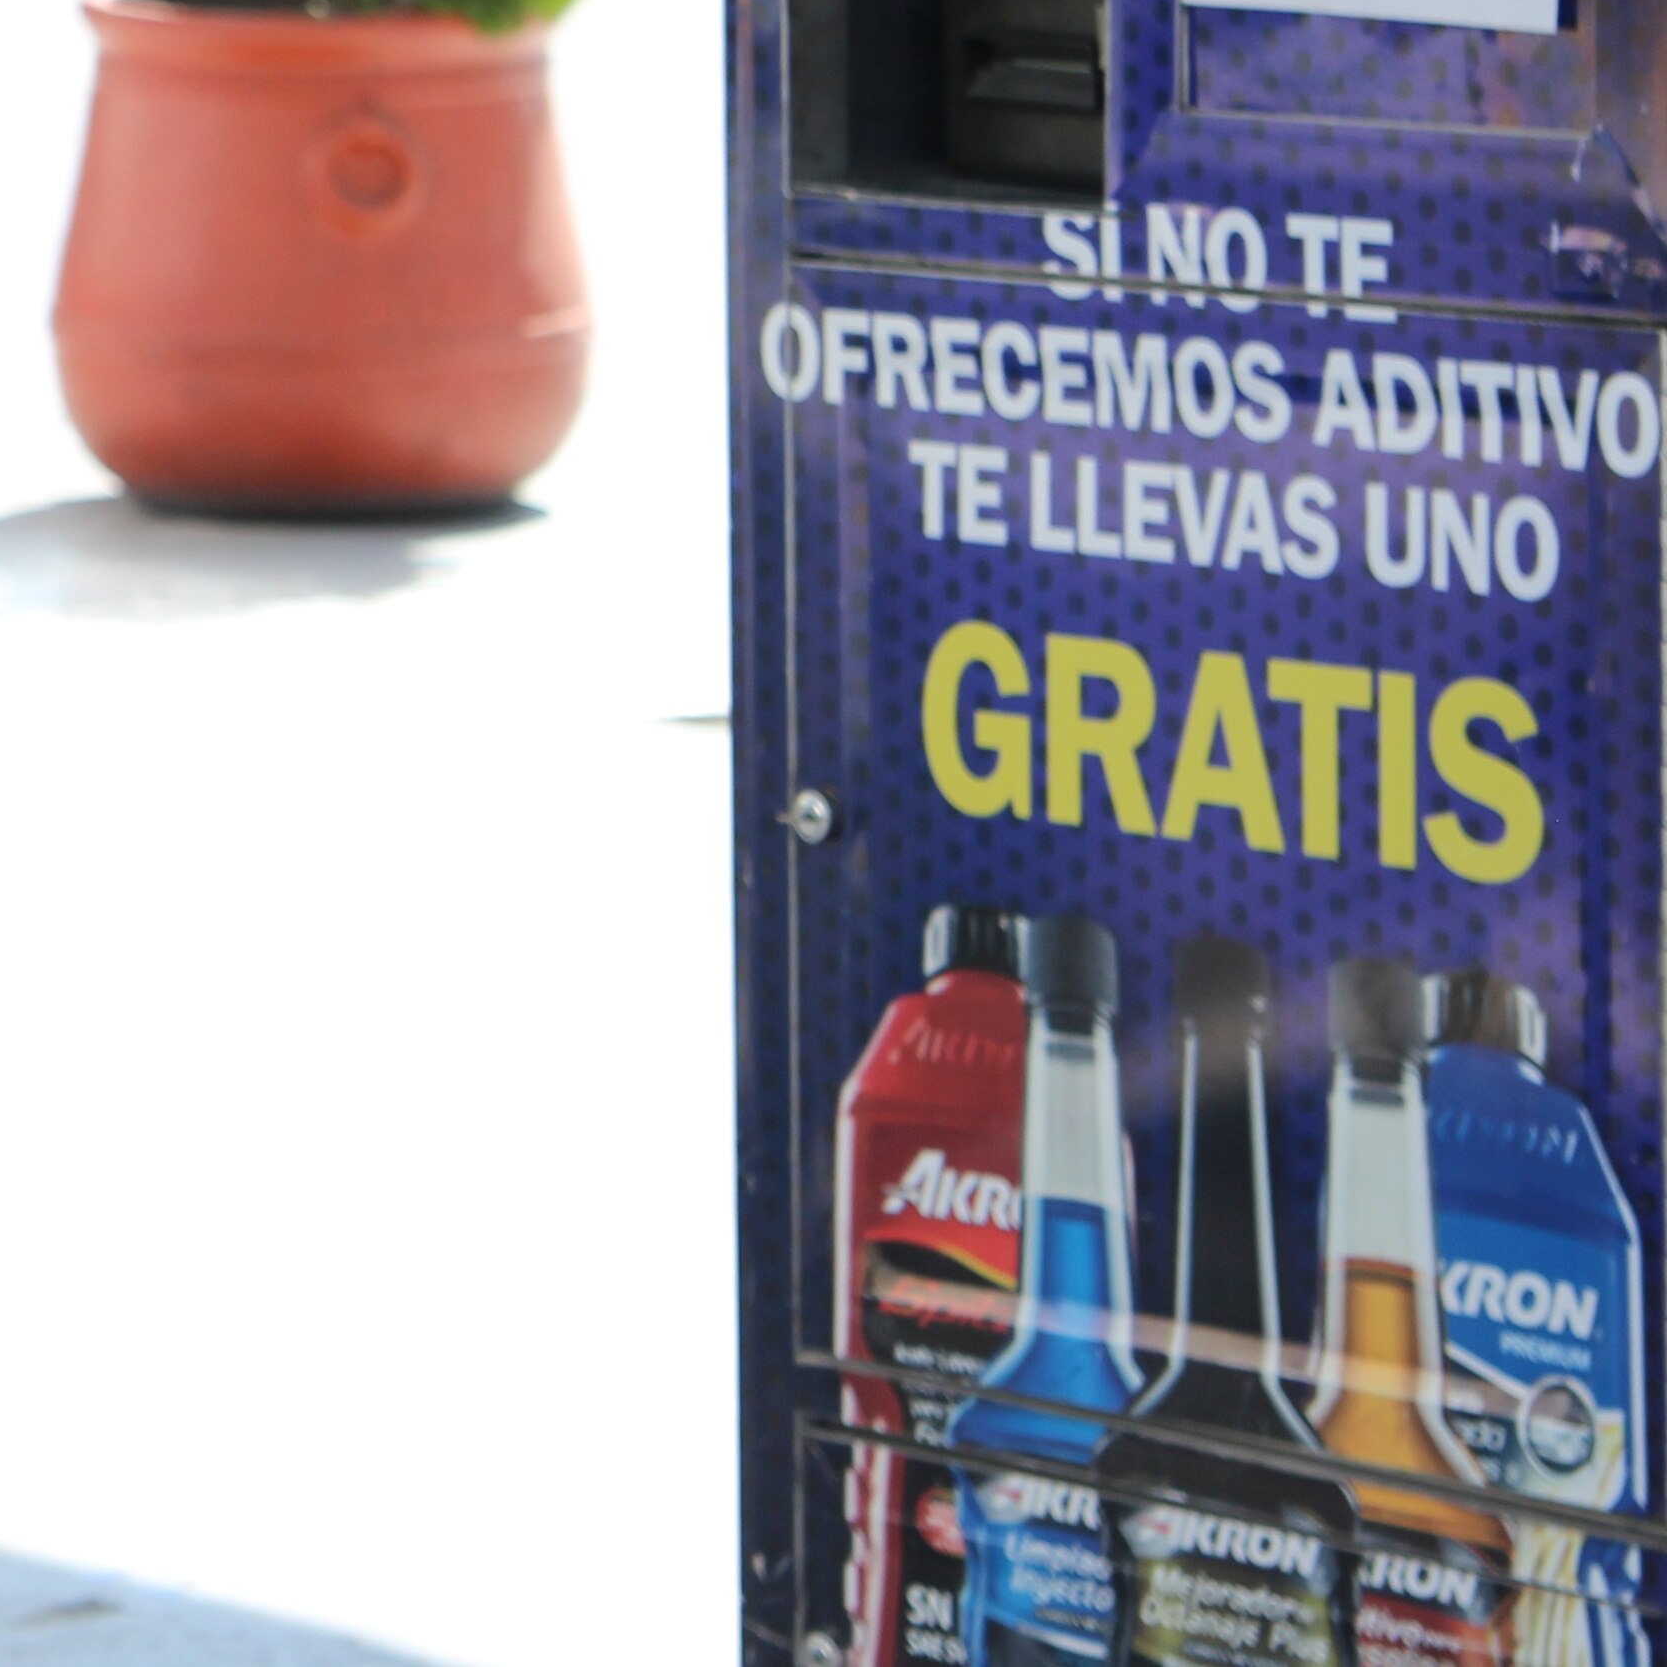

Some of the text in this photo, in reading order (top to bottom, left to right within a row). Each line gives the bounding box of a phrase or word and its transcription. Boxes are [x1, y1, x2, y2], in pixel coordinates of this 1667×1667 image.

[1146, 201, 1268, 313] NO
[1285, 212, 1398, 324] TE
[761, 302, 1661, 480] OFRECEMOS ADITIVO
[909, 441, 1562, 602] TE LLEVAS UNO
[922, 619, 1545, 886] GRATIS
